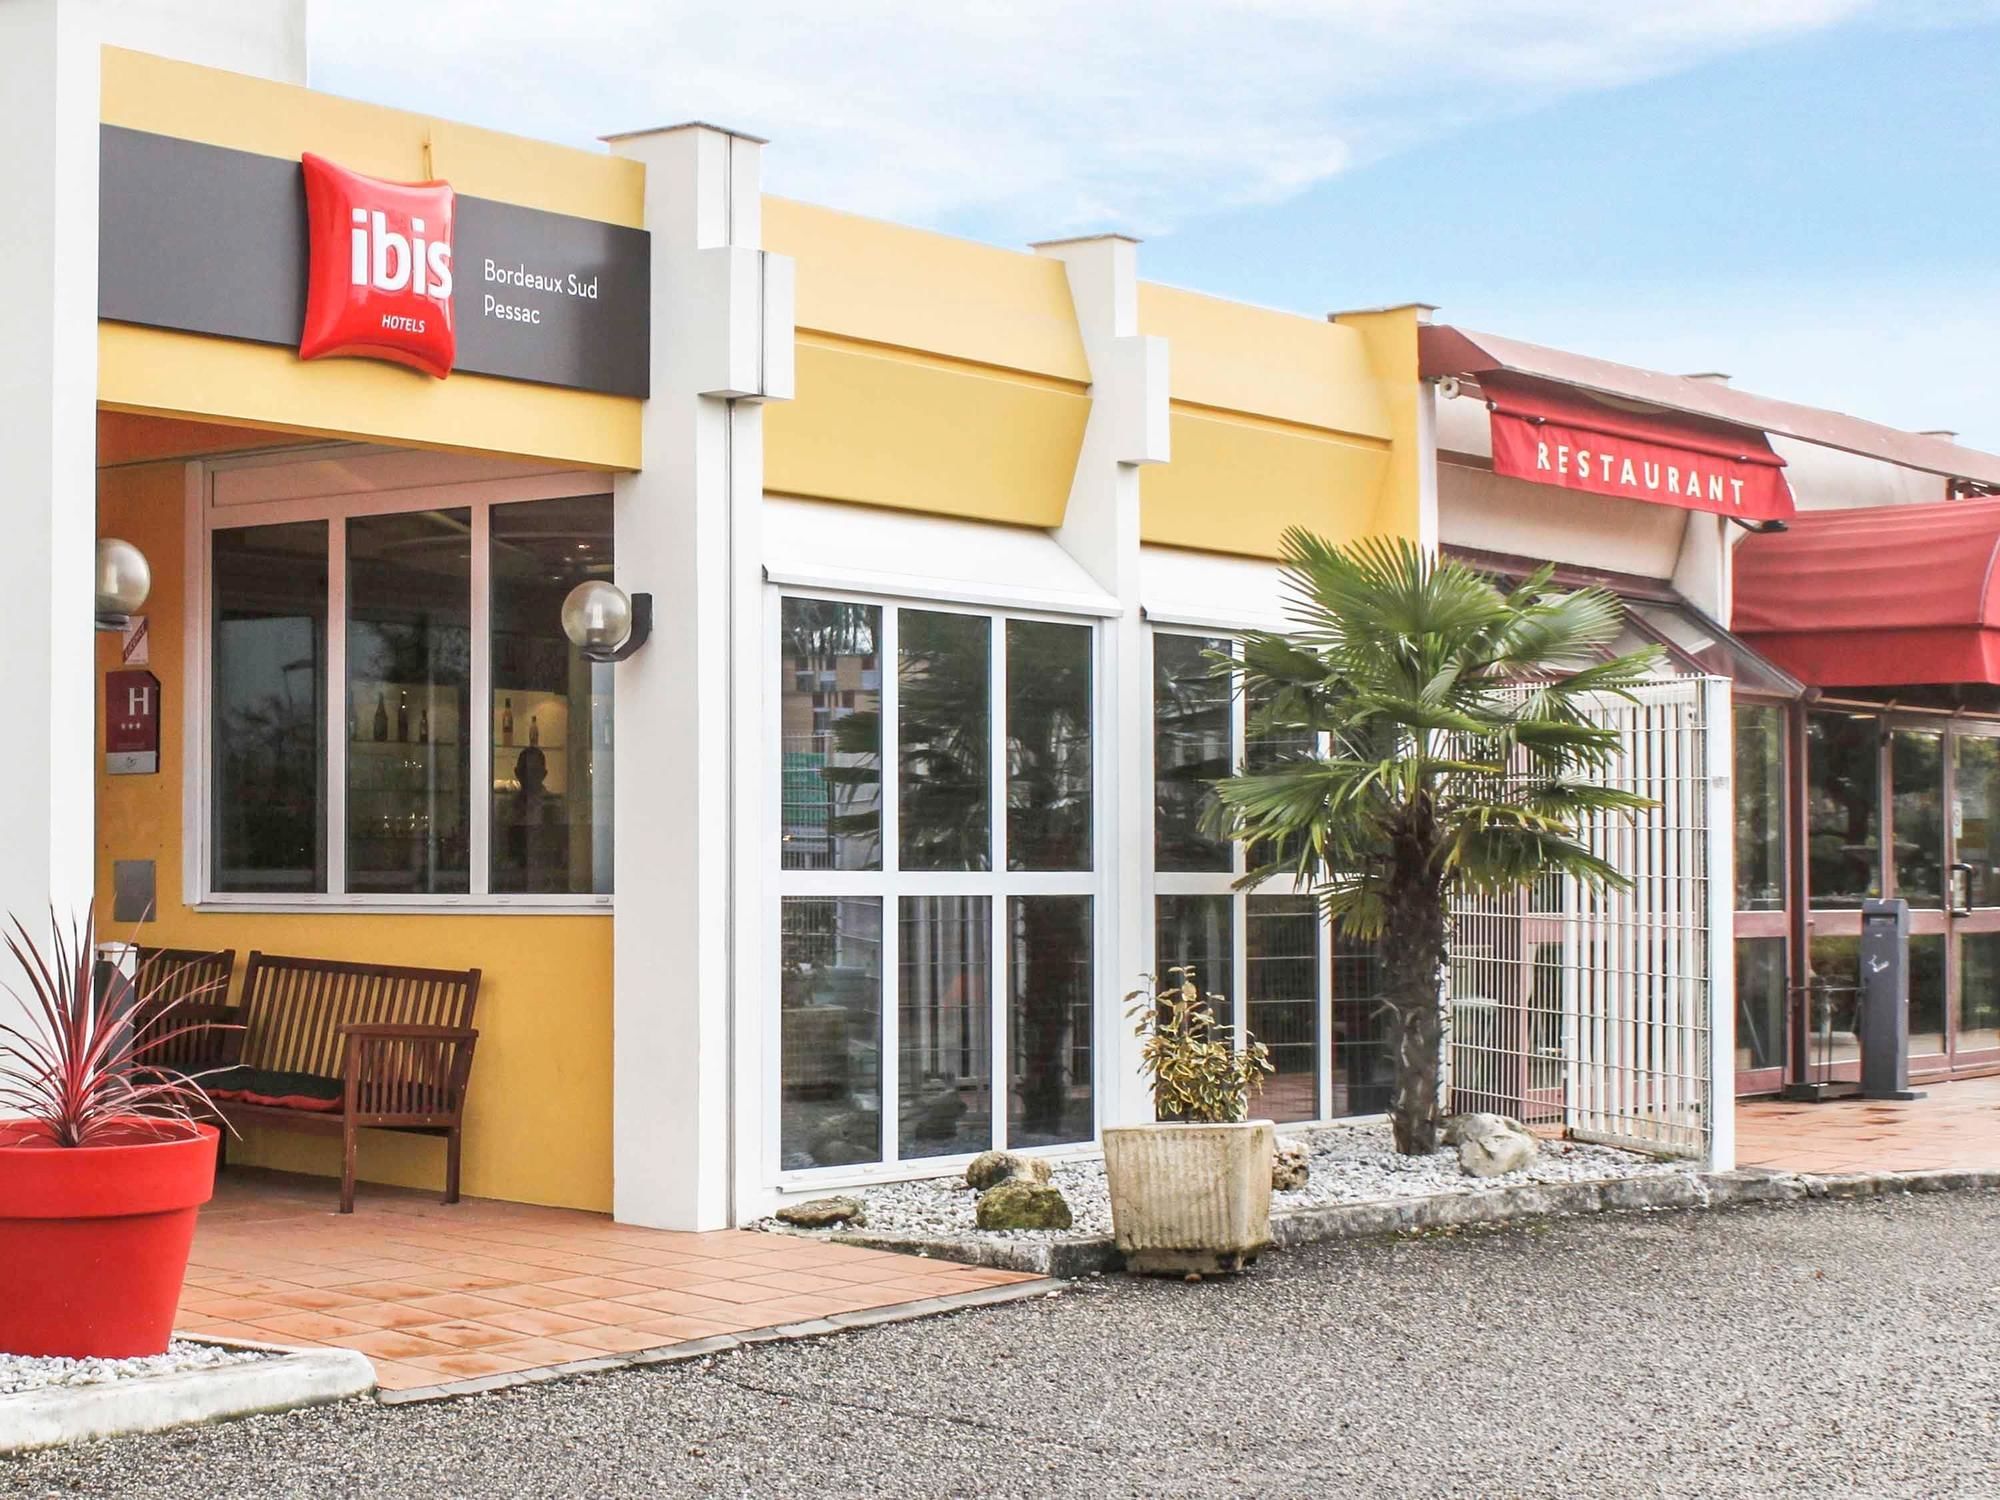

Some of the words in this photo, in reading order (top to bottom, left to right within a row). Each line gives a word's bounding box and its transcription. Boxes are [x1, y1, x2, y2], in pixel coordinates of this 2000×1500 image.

[352, 208, 453, 301] ibis
[484, 259, 563, 294] Bordeaux
[567, 274, 599, 300] Sud
[382, 314, 426, 334] HOTELS
[484, 295, 541, 325] Pessac
[1537, 441, 1744, 505] RESTAURANT
[128, 687, 150, 716] H
